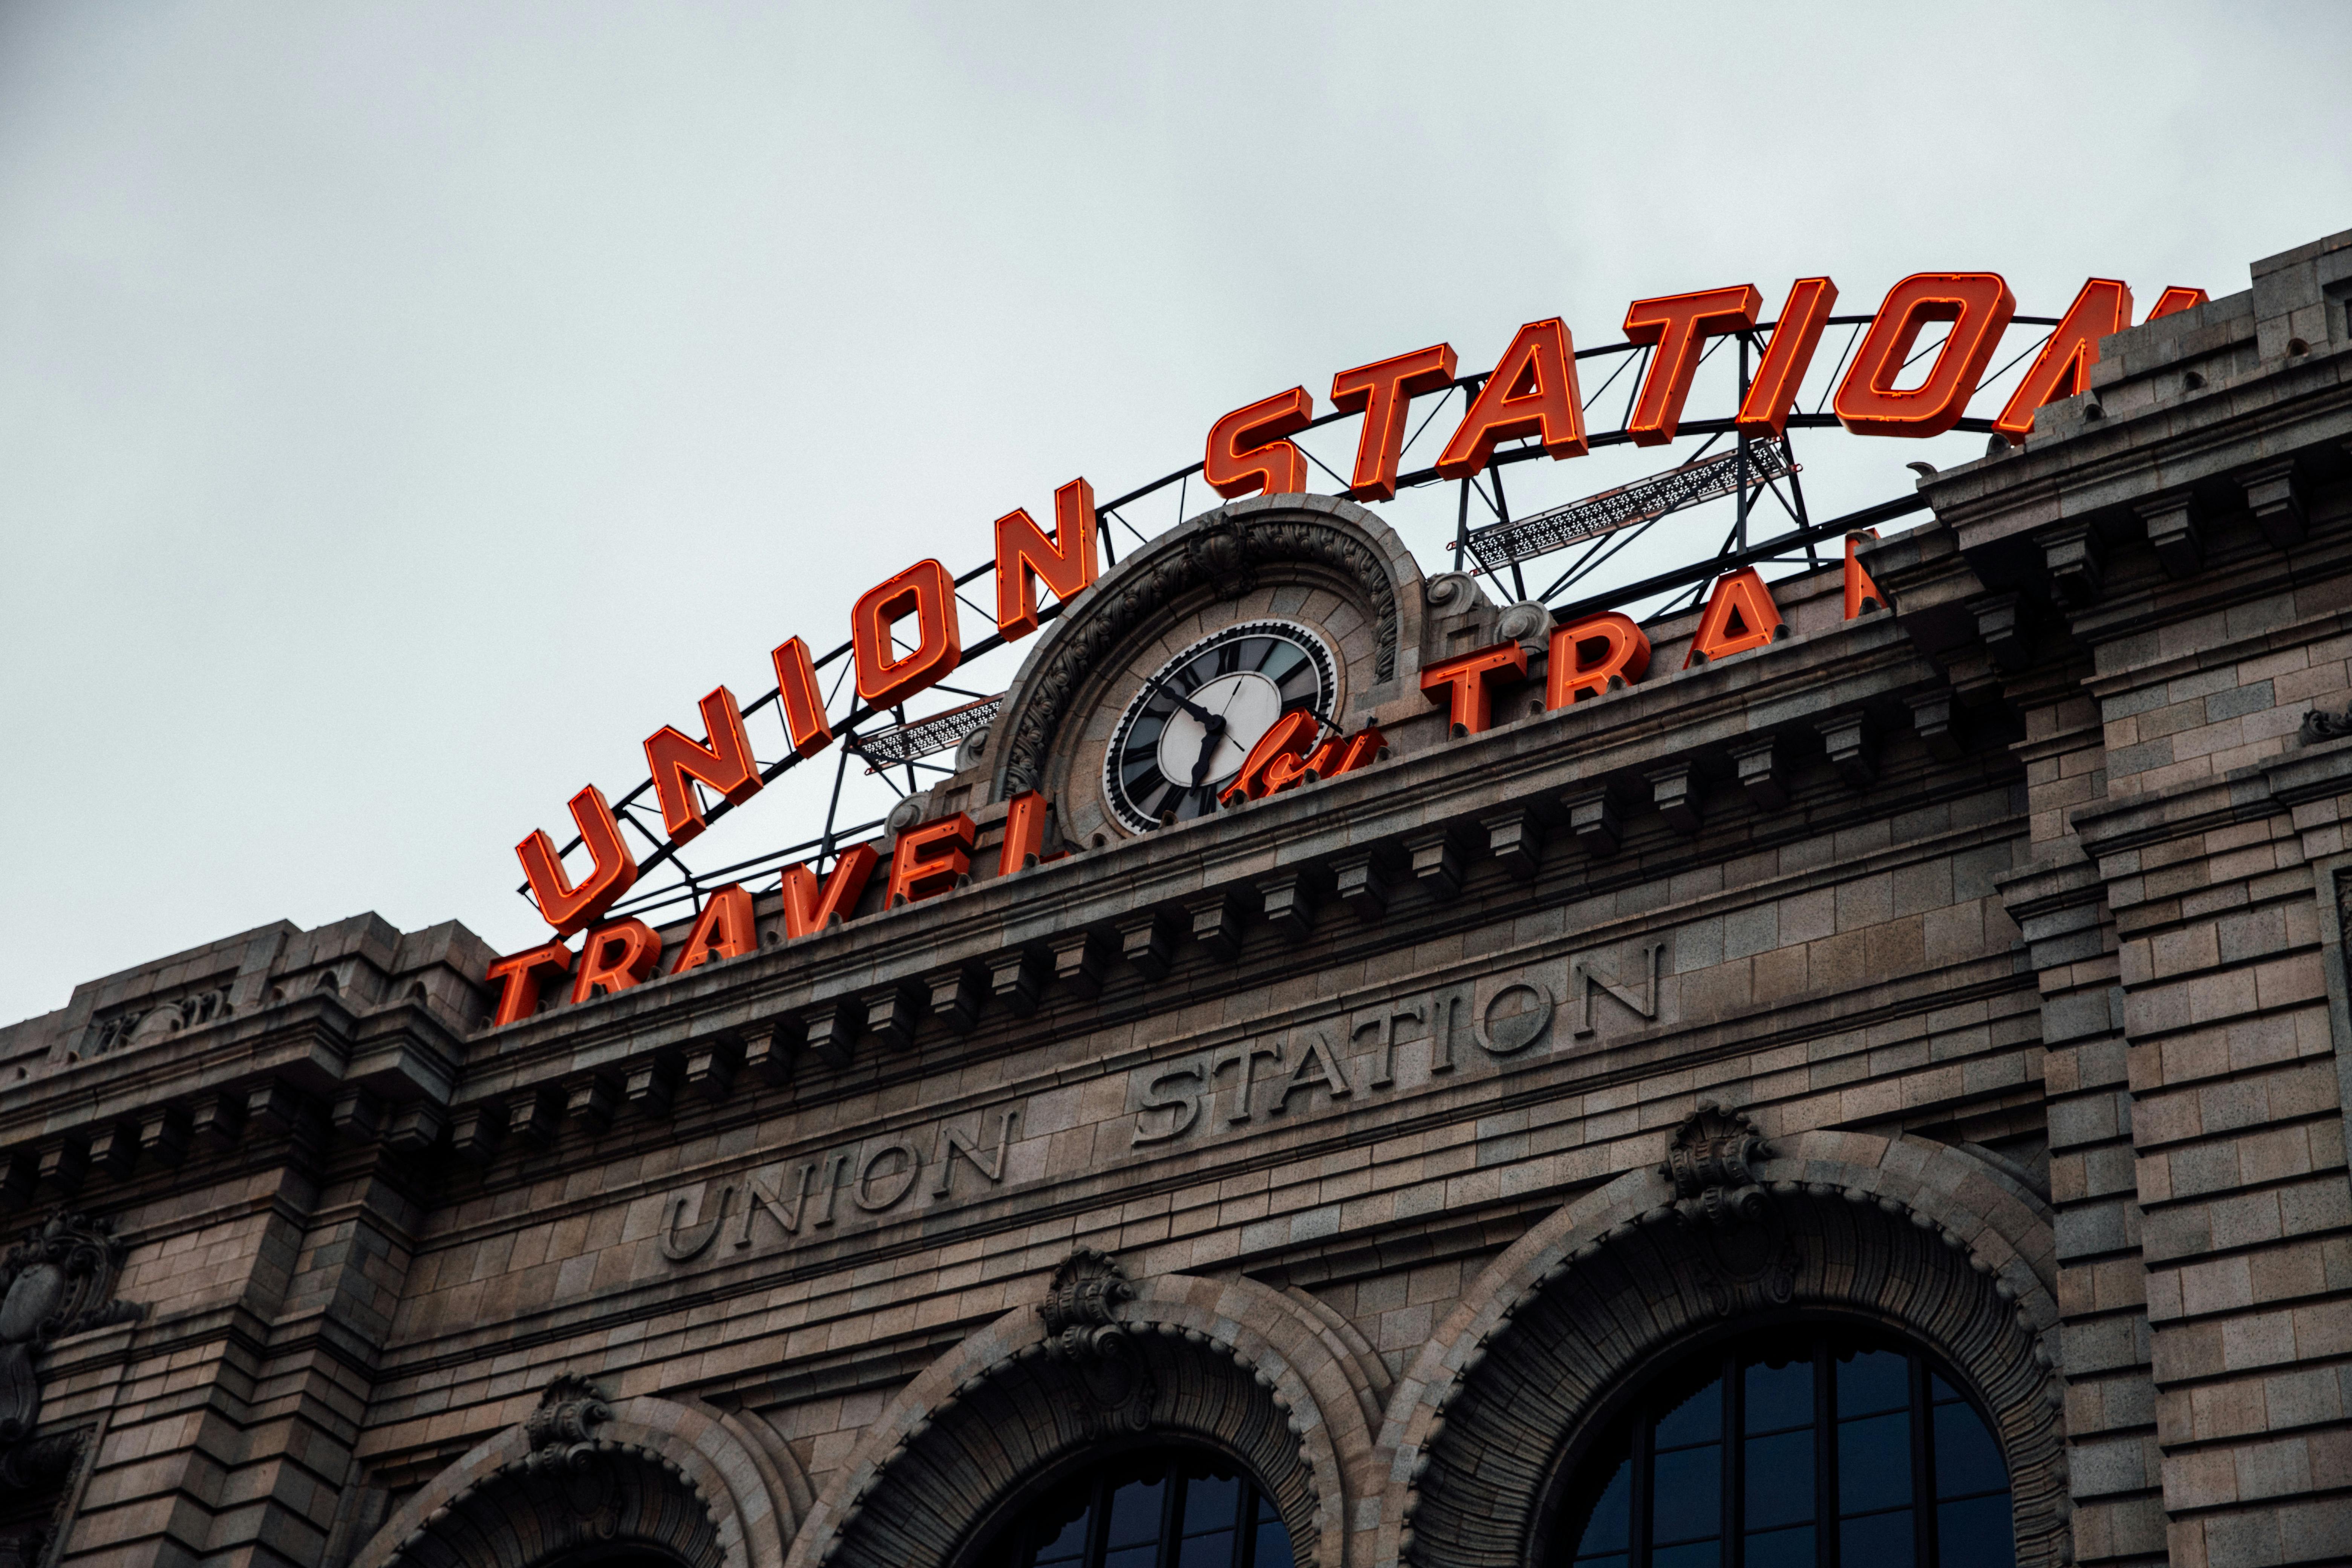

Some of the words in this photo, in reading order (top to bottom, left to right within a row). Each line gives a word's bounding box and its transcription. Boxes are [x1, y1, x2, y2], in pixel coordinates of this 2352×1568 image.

[515, 476, 1098, 937] UNION
[1204, 271, 2210, 504] STATION
[660, 1111, 1017, 1261] UNION
[1131, 942, 1664, 1148] STATION
